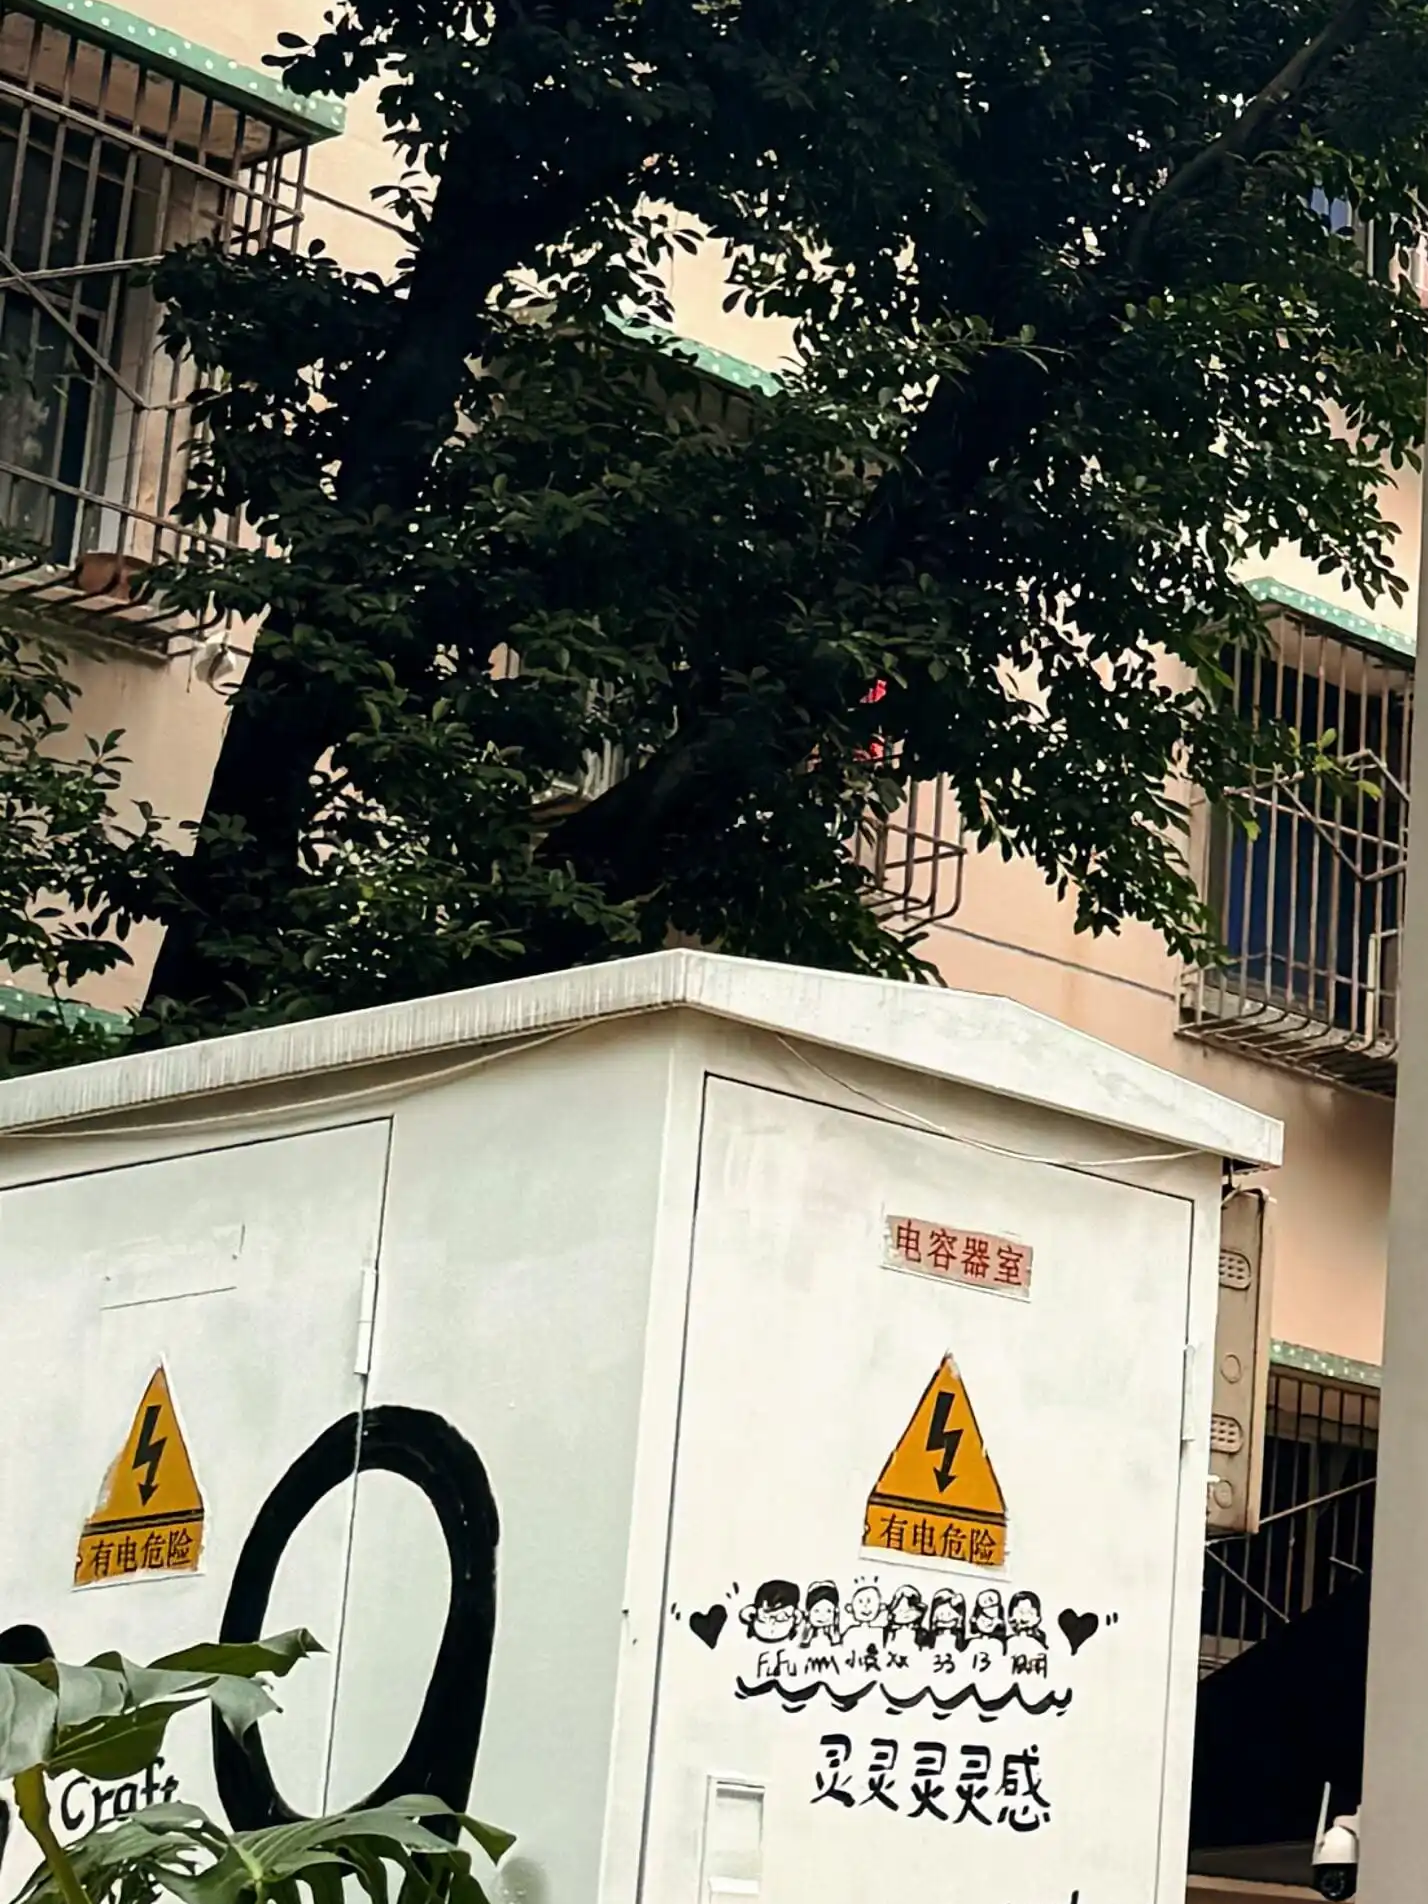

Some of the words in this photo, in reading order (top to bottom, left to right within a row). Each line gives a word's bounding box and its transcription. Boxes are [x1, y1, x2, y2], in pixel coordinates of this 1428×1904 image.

[895, 1218, 1024, 1288] 电容器室
[89, 1528, 193, 1577] 有电危险
[880, 1513, 998, 1566] 有电危险
[810, 1733, 1053, 1832] 灵灵灵灵感
